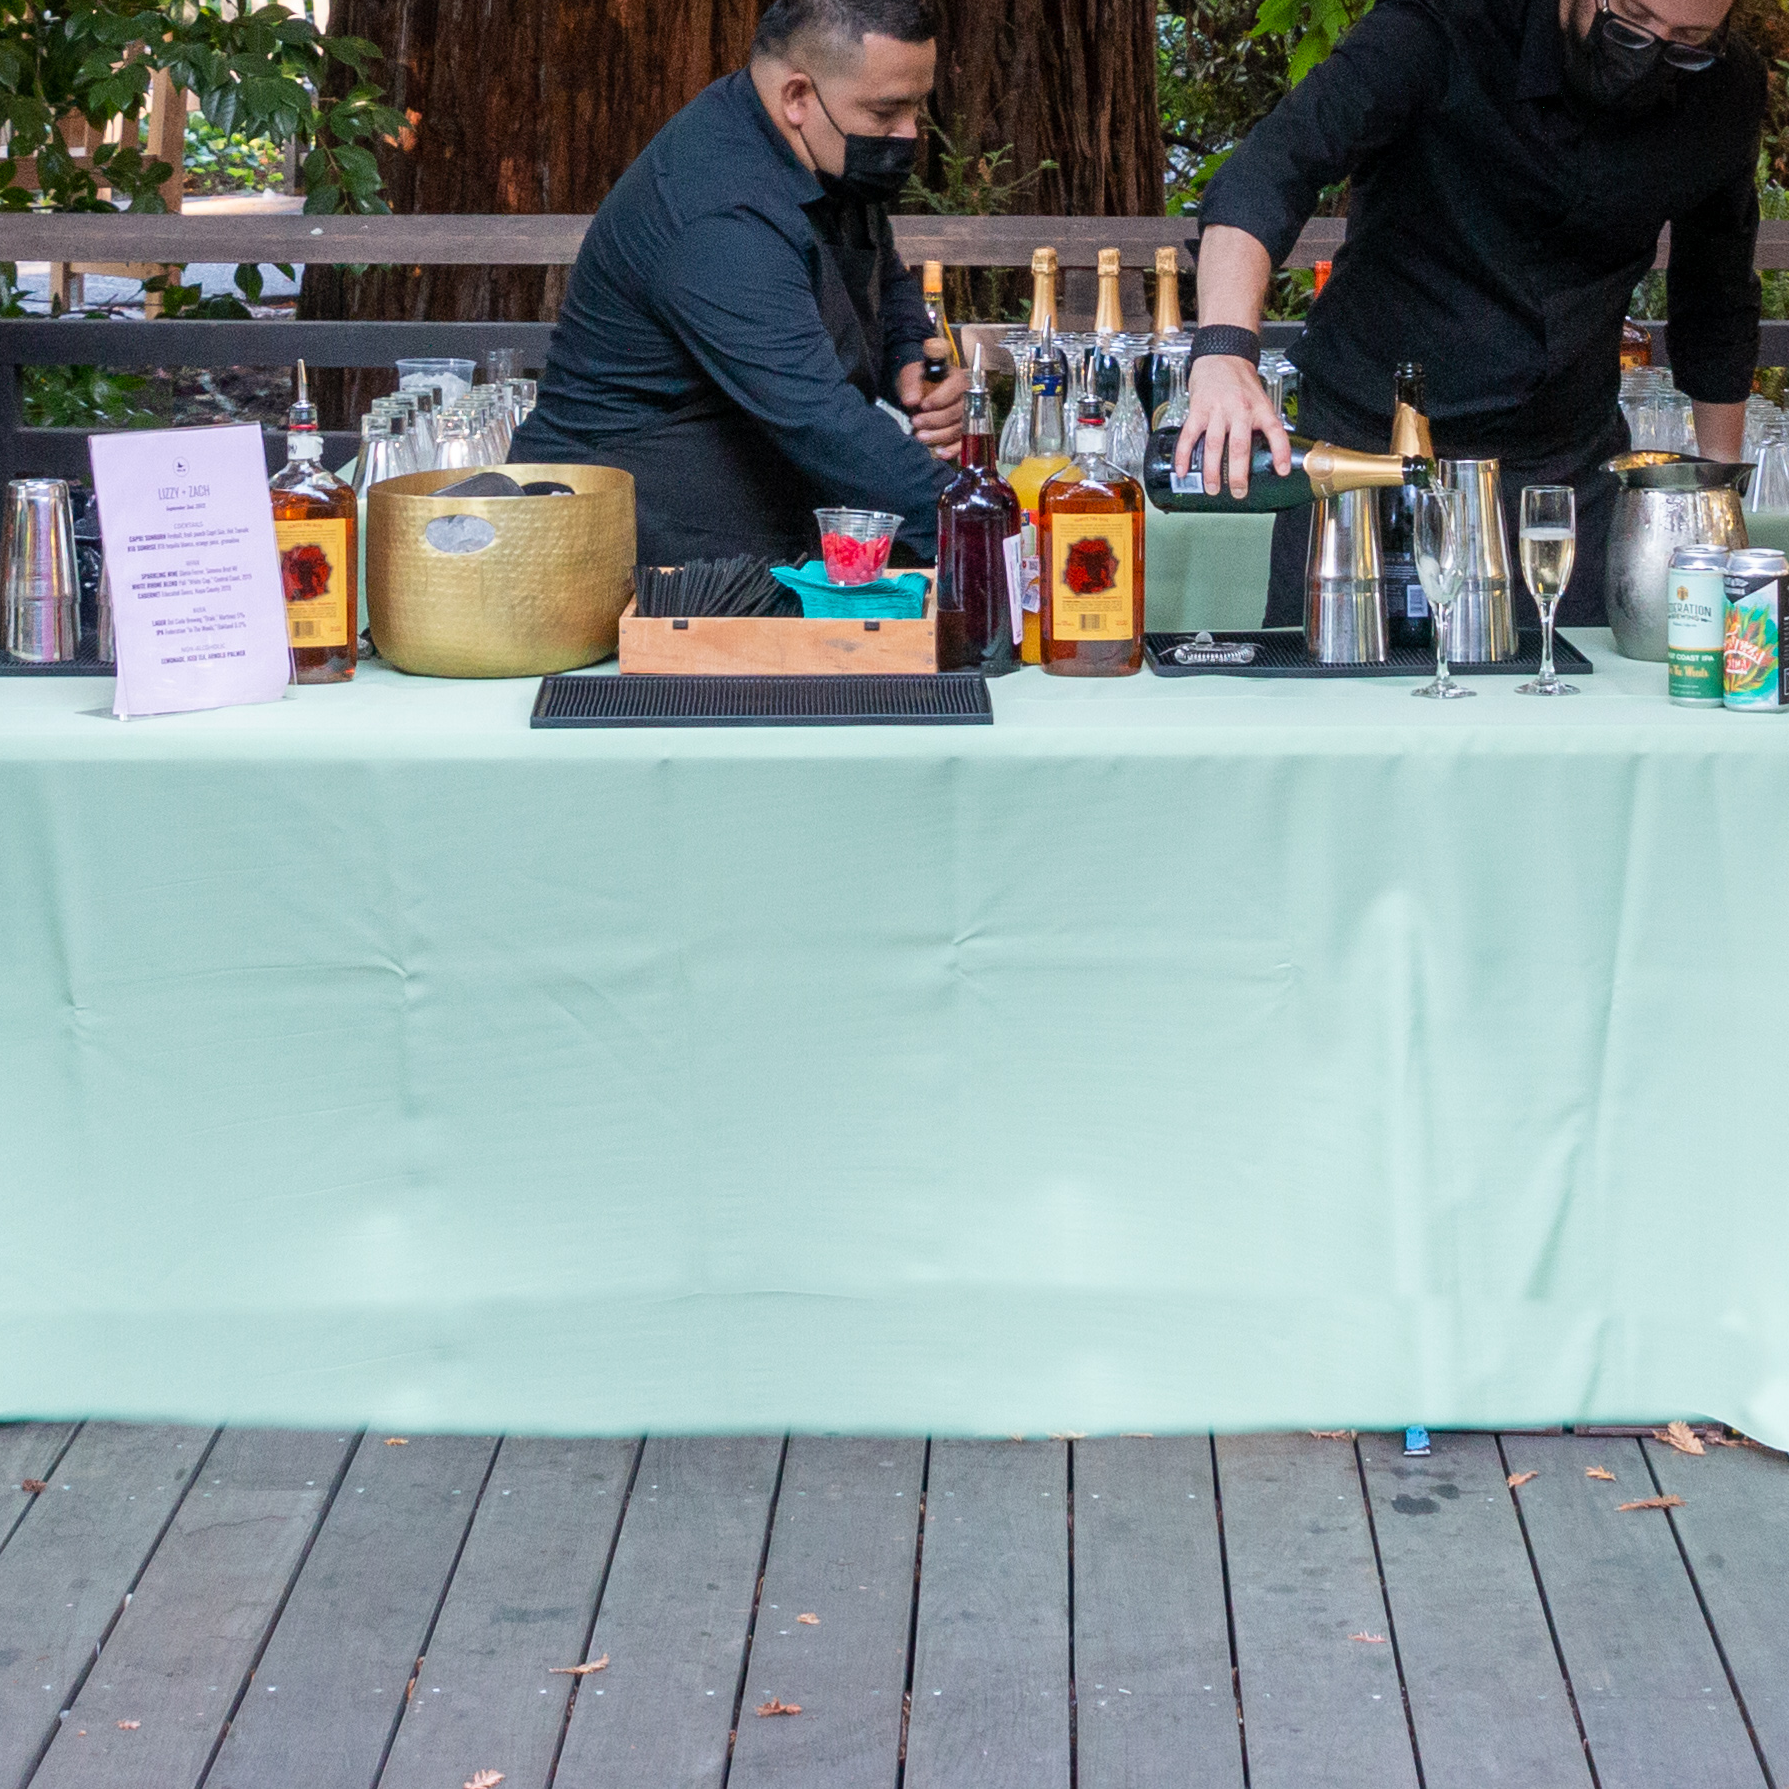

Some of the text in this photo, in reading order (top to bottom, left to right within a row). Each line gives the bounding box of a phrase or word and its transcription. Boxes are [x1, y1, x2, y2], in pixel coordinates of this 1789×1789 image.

[158, 487, 179, 500] LIZZY
[188, 485, 210, 497] ZACH
[173, 521, 203, 529] COCKTAILS
[1676, 653, 1699, 662] COAST
[1701, 654, 1715, 662] IPA
